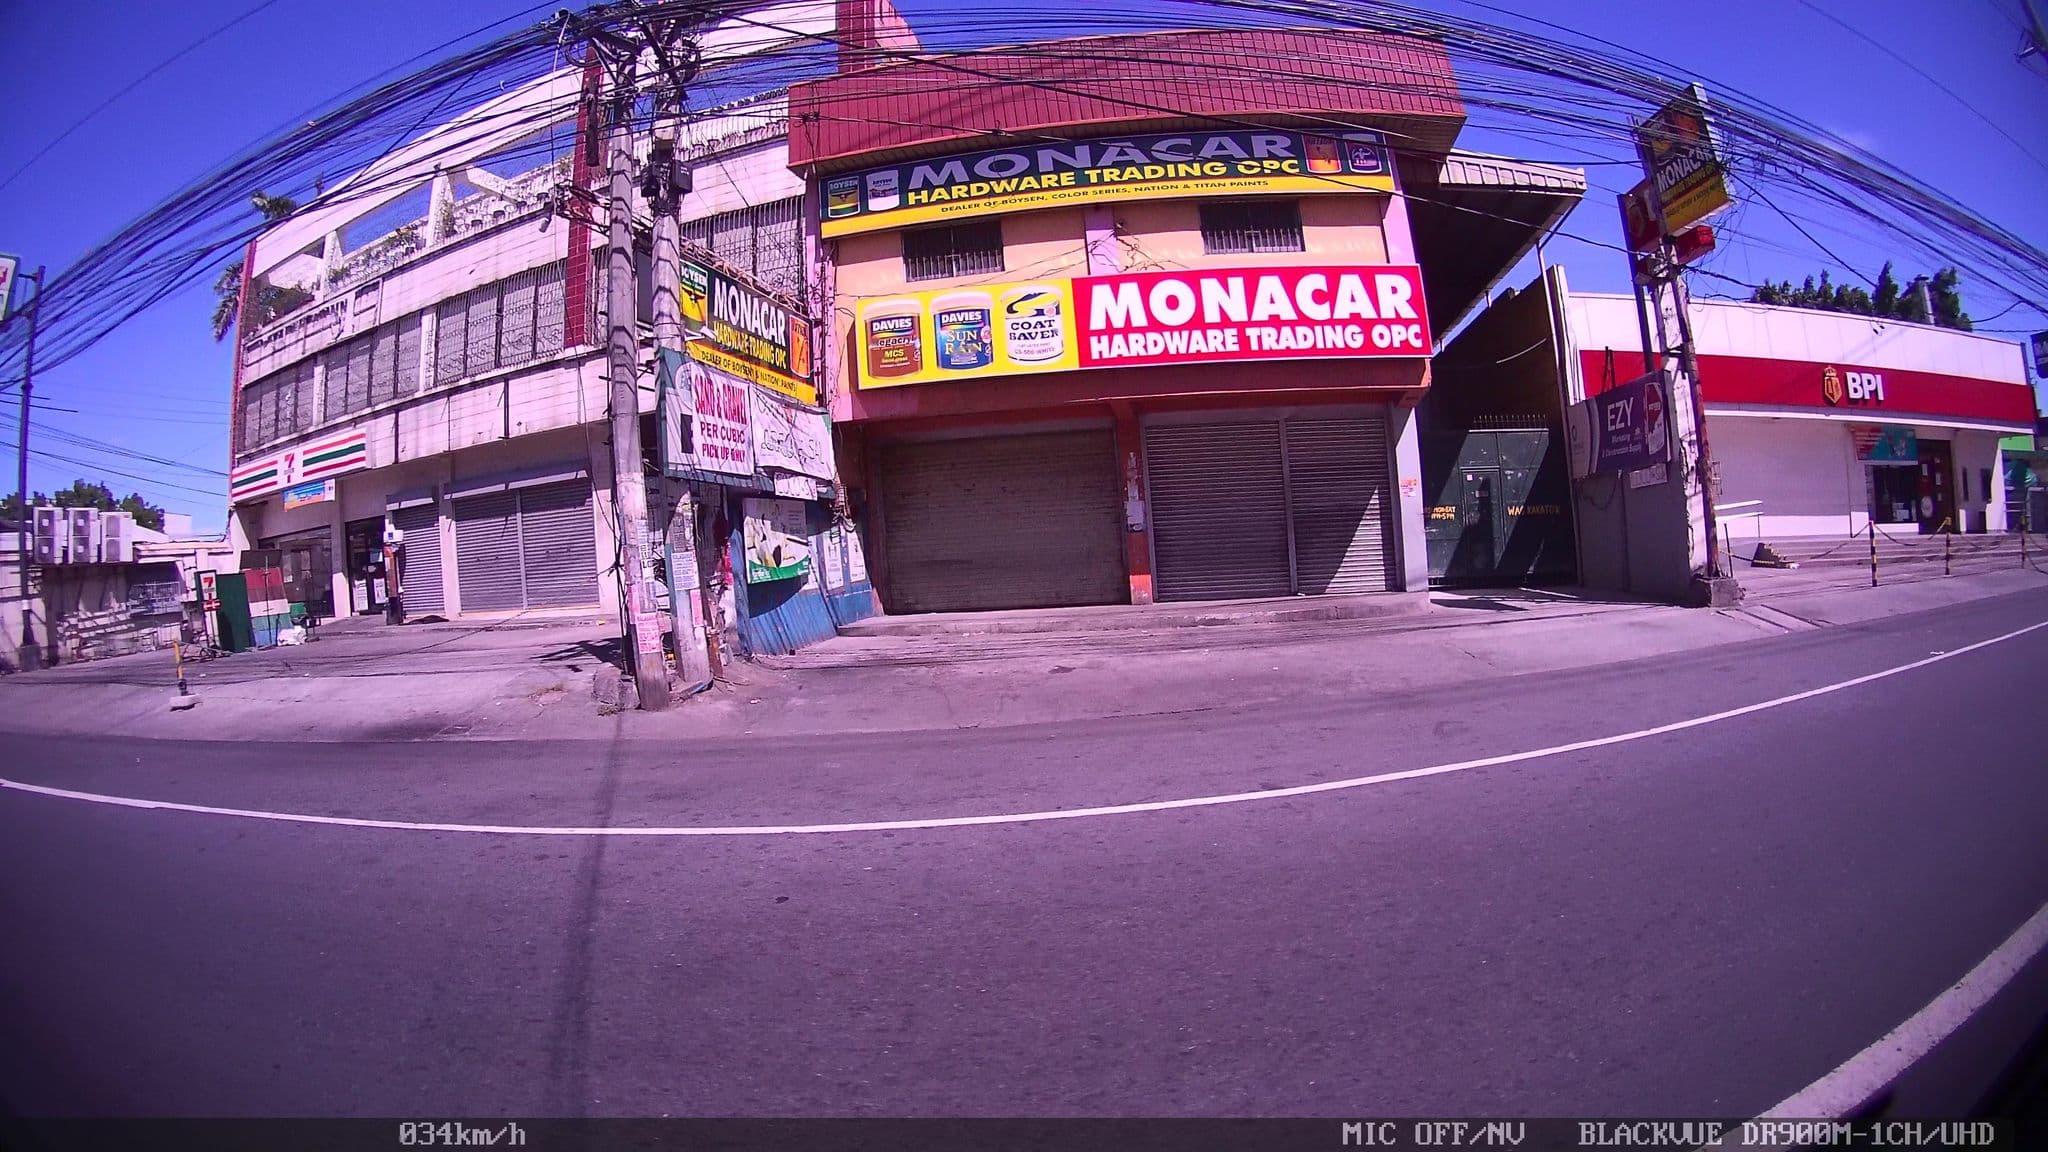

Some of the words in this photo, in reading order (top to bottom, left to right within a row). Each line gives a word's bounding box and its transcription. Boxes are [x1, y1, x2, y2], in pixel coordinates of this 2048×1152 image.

[908, 134, 1296, 190] MONACAR
[907, 171, 1076, 205] HARDWARE
[1085, 161, 1227, 184] TRADING
[1237, 159, 1300, 174] OPC
[941, 203, 980, 213] DEALER
[984, 200, 997, 208] OF
[1001, 195, 1047, 205] BOYSEN,
[1051, 190, 1089, 199] COLOR
[1092, 187, 1131, 196] SERIES,
[1134, 183, 1180, 192] NATION
[1194, 181, 1226, 189] TITAN
[1230, 179, 1268, 187] PAINTS
[714, 278, 786, 347] MONACAR
[941, 311, 982, 324] DAVIES
[1089, 273, 1419, 331] MONACAR
[872, 318, 912, 332] DAVIES
[946, 330, 977, 342] SUN
[1010, 319, 1056, 331] COAT
[713, 321, 749, 354] HARDWARE
[749, 336, 775, 364] TRADING
[884, 349, 904, 358] MCS
[1089, 327, 1240, 360] HARDWARE
[1246, 325, 1365, 351] TRADING
[1371, 324, 1423, 349] OPC
[701, 350, 721, 365] DEALER
[723, 358, 731, 368] OF
[694, 374, 715, 417] SAND
[716, 389, 722, 416] &
[722, 383, 747, 426] GRAVEL
[1845, 371, 1885, 401] BPI
[1607, 397, 1633, 431] EZY
[700, 420, 719, 439] PER
[720, 425, 746, 444] CUBIC
[702, 443, 719, 460] PICK
[720, 446, 730, 461] UP
[731, 448, 746, 463] ONLY
